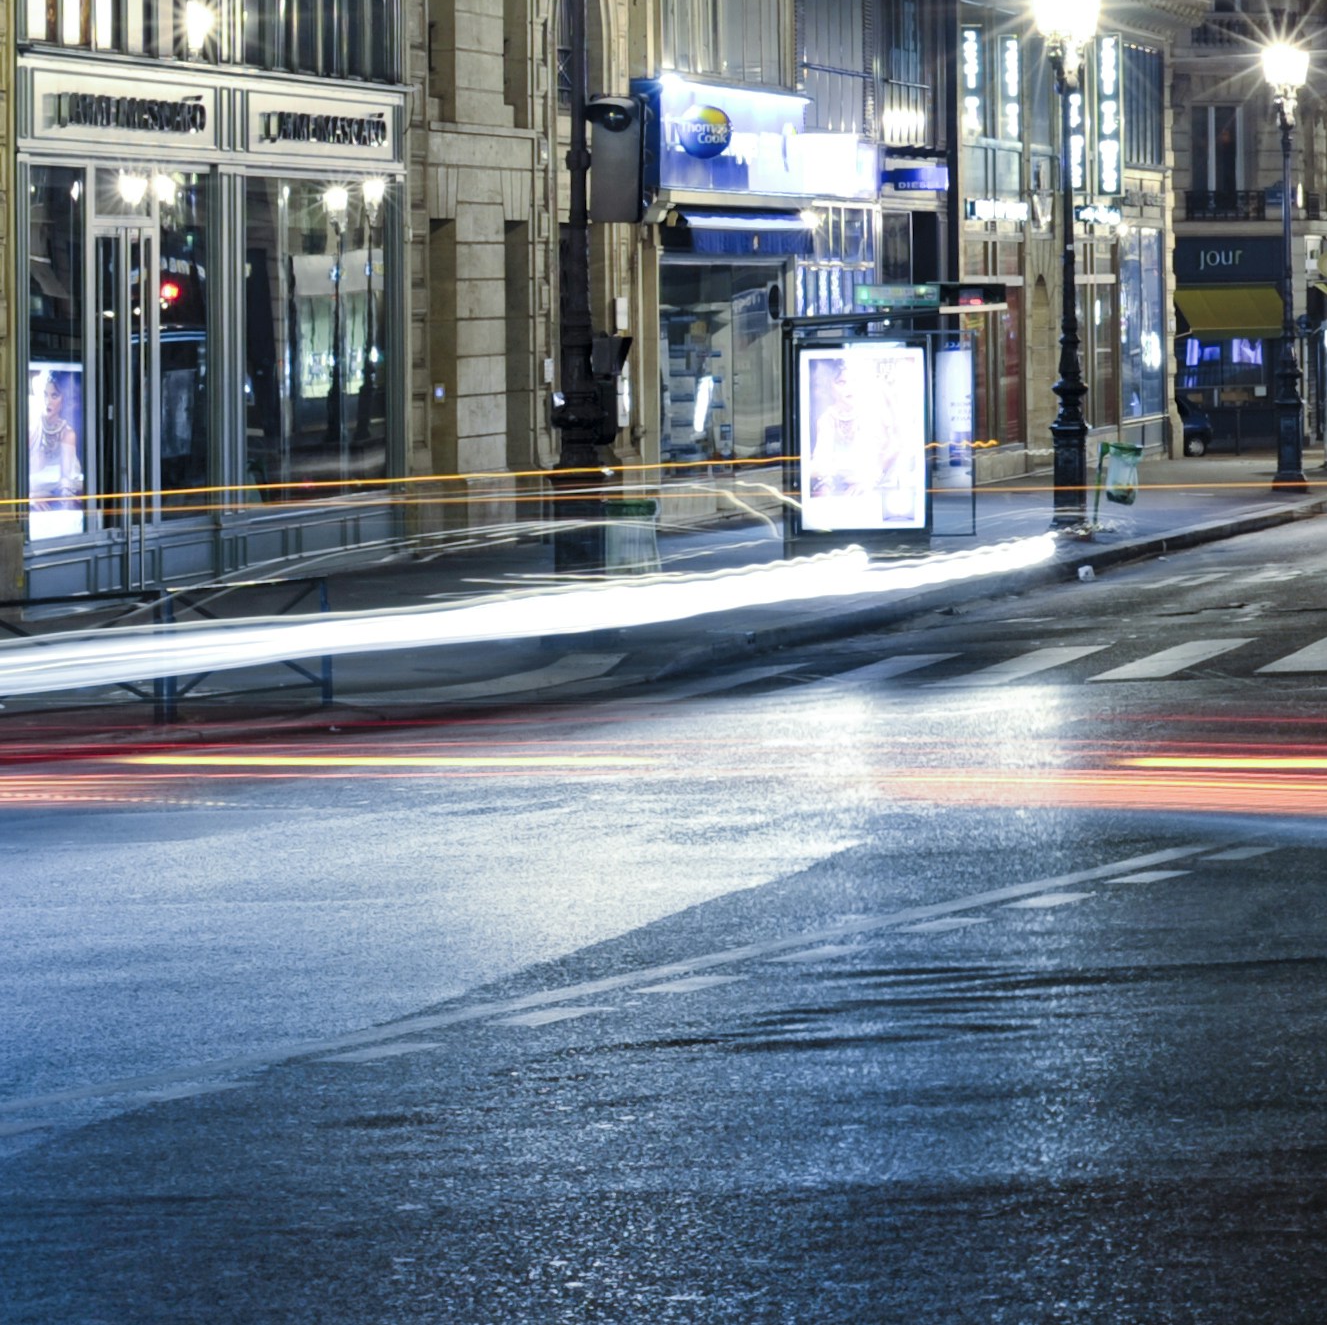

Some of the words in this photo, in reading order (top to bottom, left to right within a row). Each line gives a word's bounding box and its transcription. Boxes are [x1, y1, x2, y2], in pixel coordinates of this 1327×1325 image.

[682, 123, 729, 134] Thomas
[697, 133, 727, 145] Cook
[1199, 248, 1243, 270] jour
